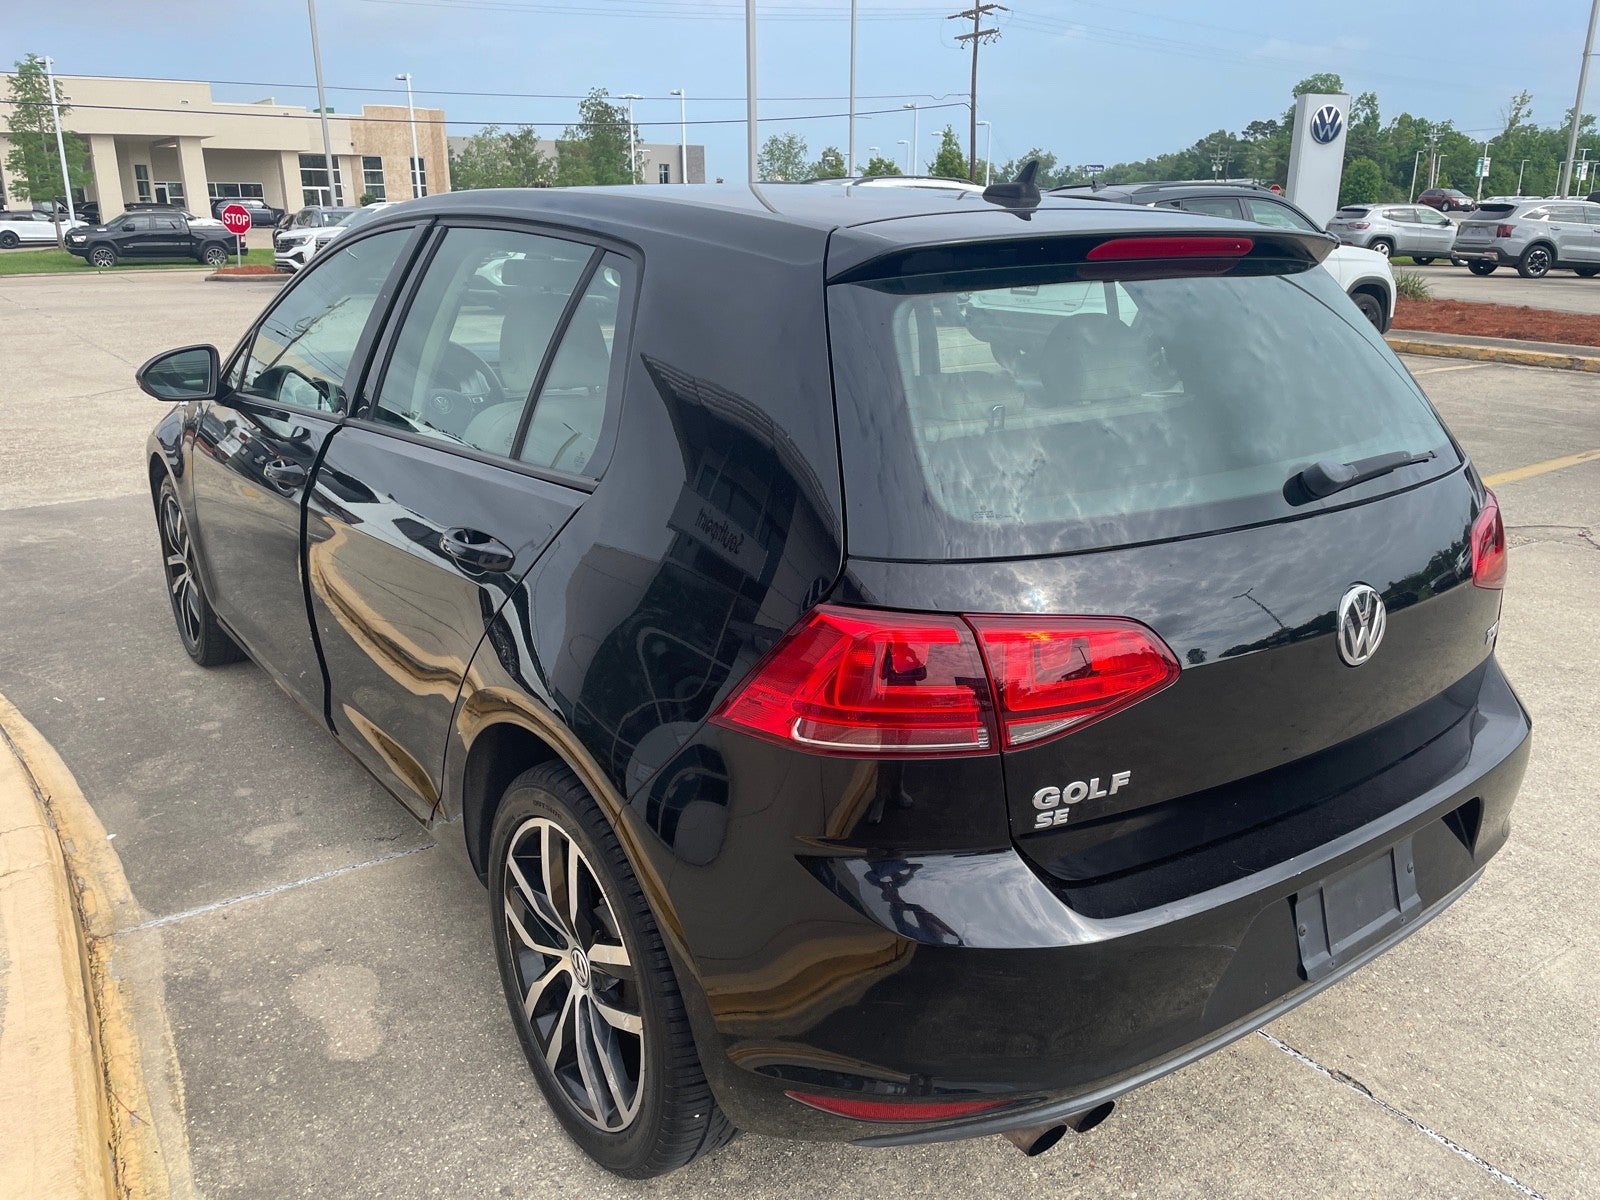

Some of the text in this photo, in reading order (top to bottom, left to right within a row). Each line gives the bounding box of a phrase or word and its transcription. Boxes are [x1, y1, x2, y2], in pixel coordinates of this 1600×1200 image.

[1311, 104, 1343, 145] VW
[224, 213, 249, 226] STOP
[1339, 585, 1386, 665] VW
[1032, 770, 1132, 810] GOLF
[1034, 807, 1070, 829] SE
